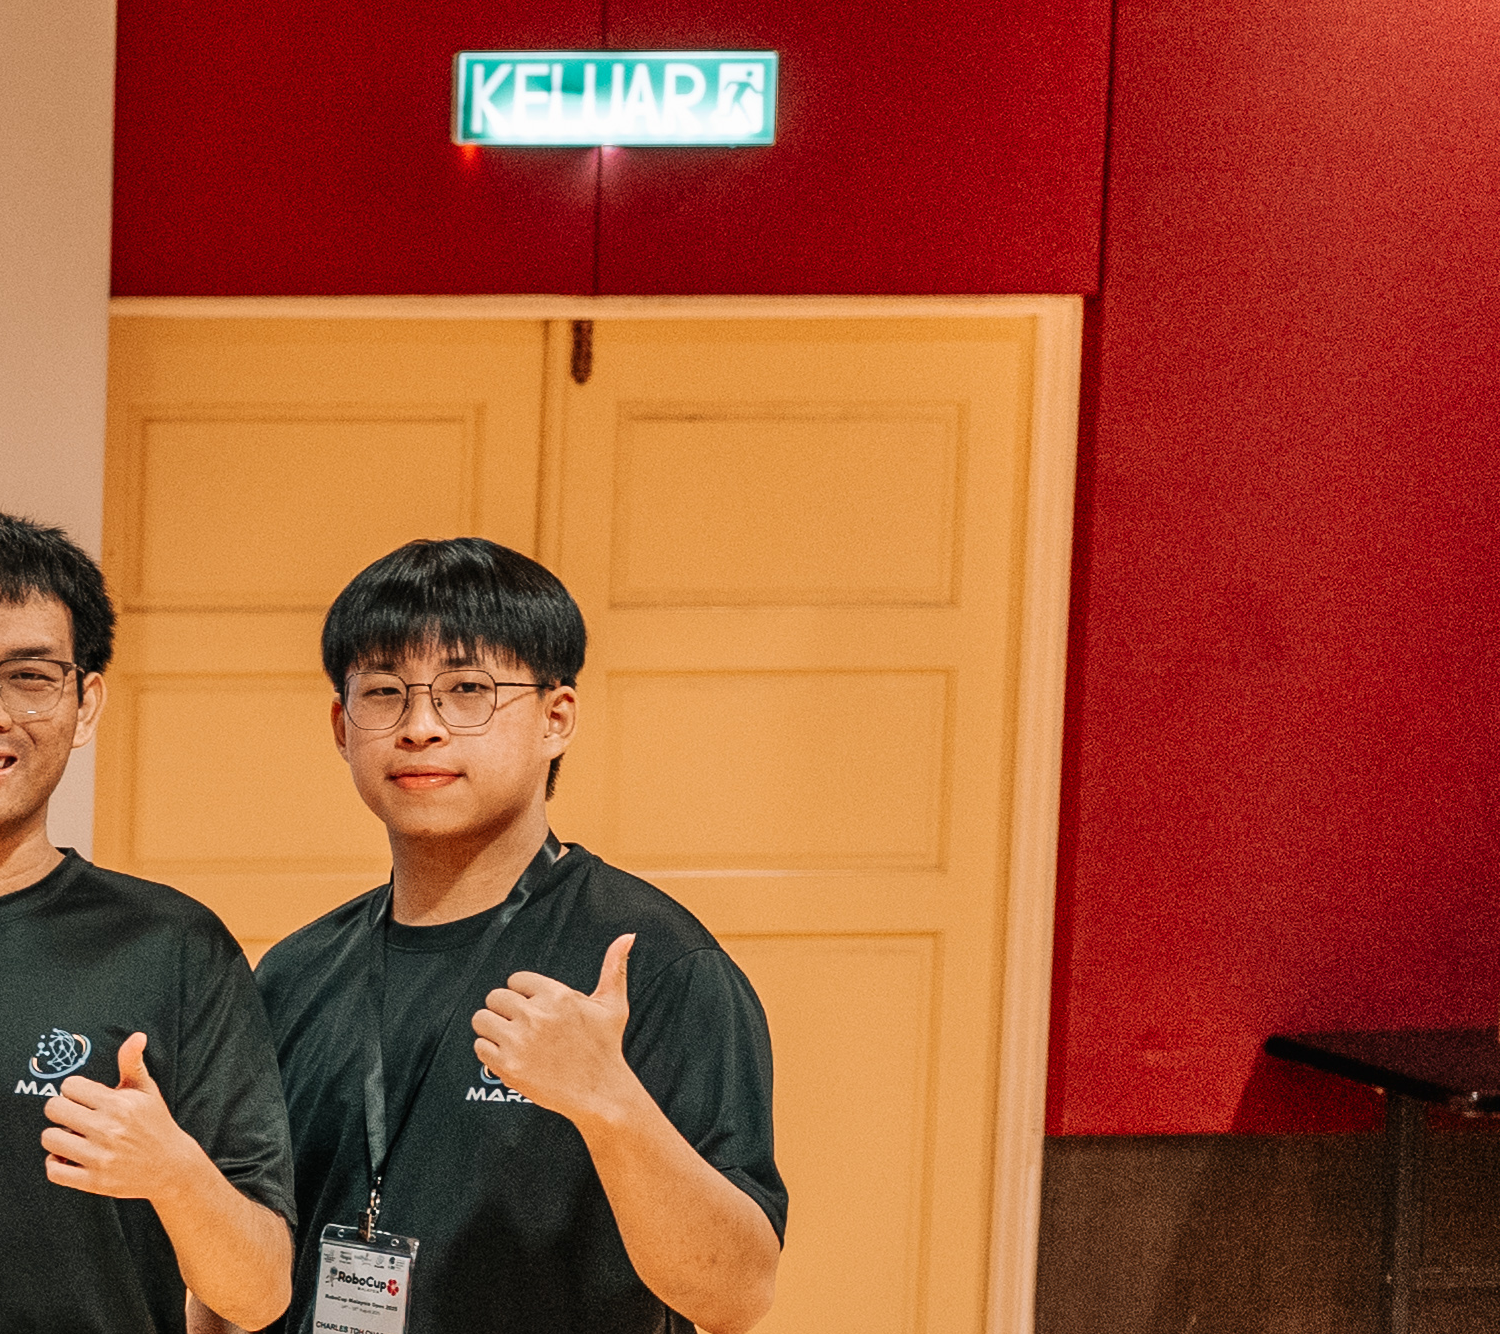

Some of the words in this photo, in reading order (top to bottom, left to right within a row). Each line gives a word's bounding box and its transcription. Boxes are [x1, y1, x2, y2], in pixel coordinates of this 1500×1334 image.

[470, 63, 708, 136] KELUAR
[14, 1079, 63, 1097] MA
[465, 1087, 534, 1104] MAR
[338, 1271, 386, 1292] RoboCup
[316, 1321, 348, 1333] CHARLES
